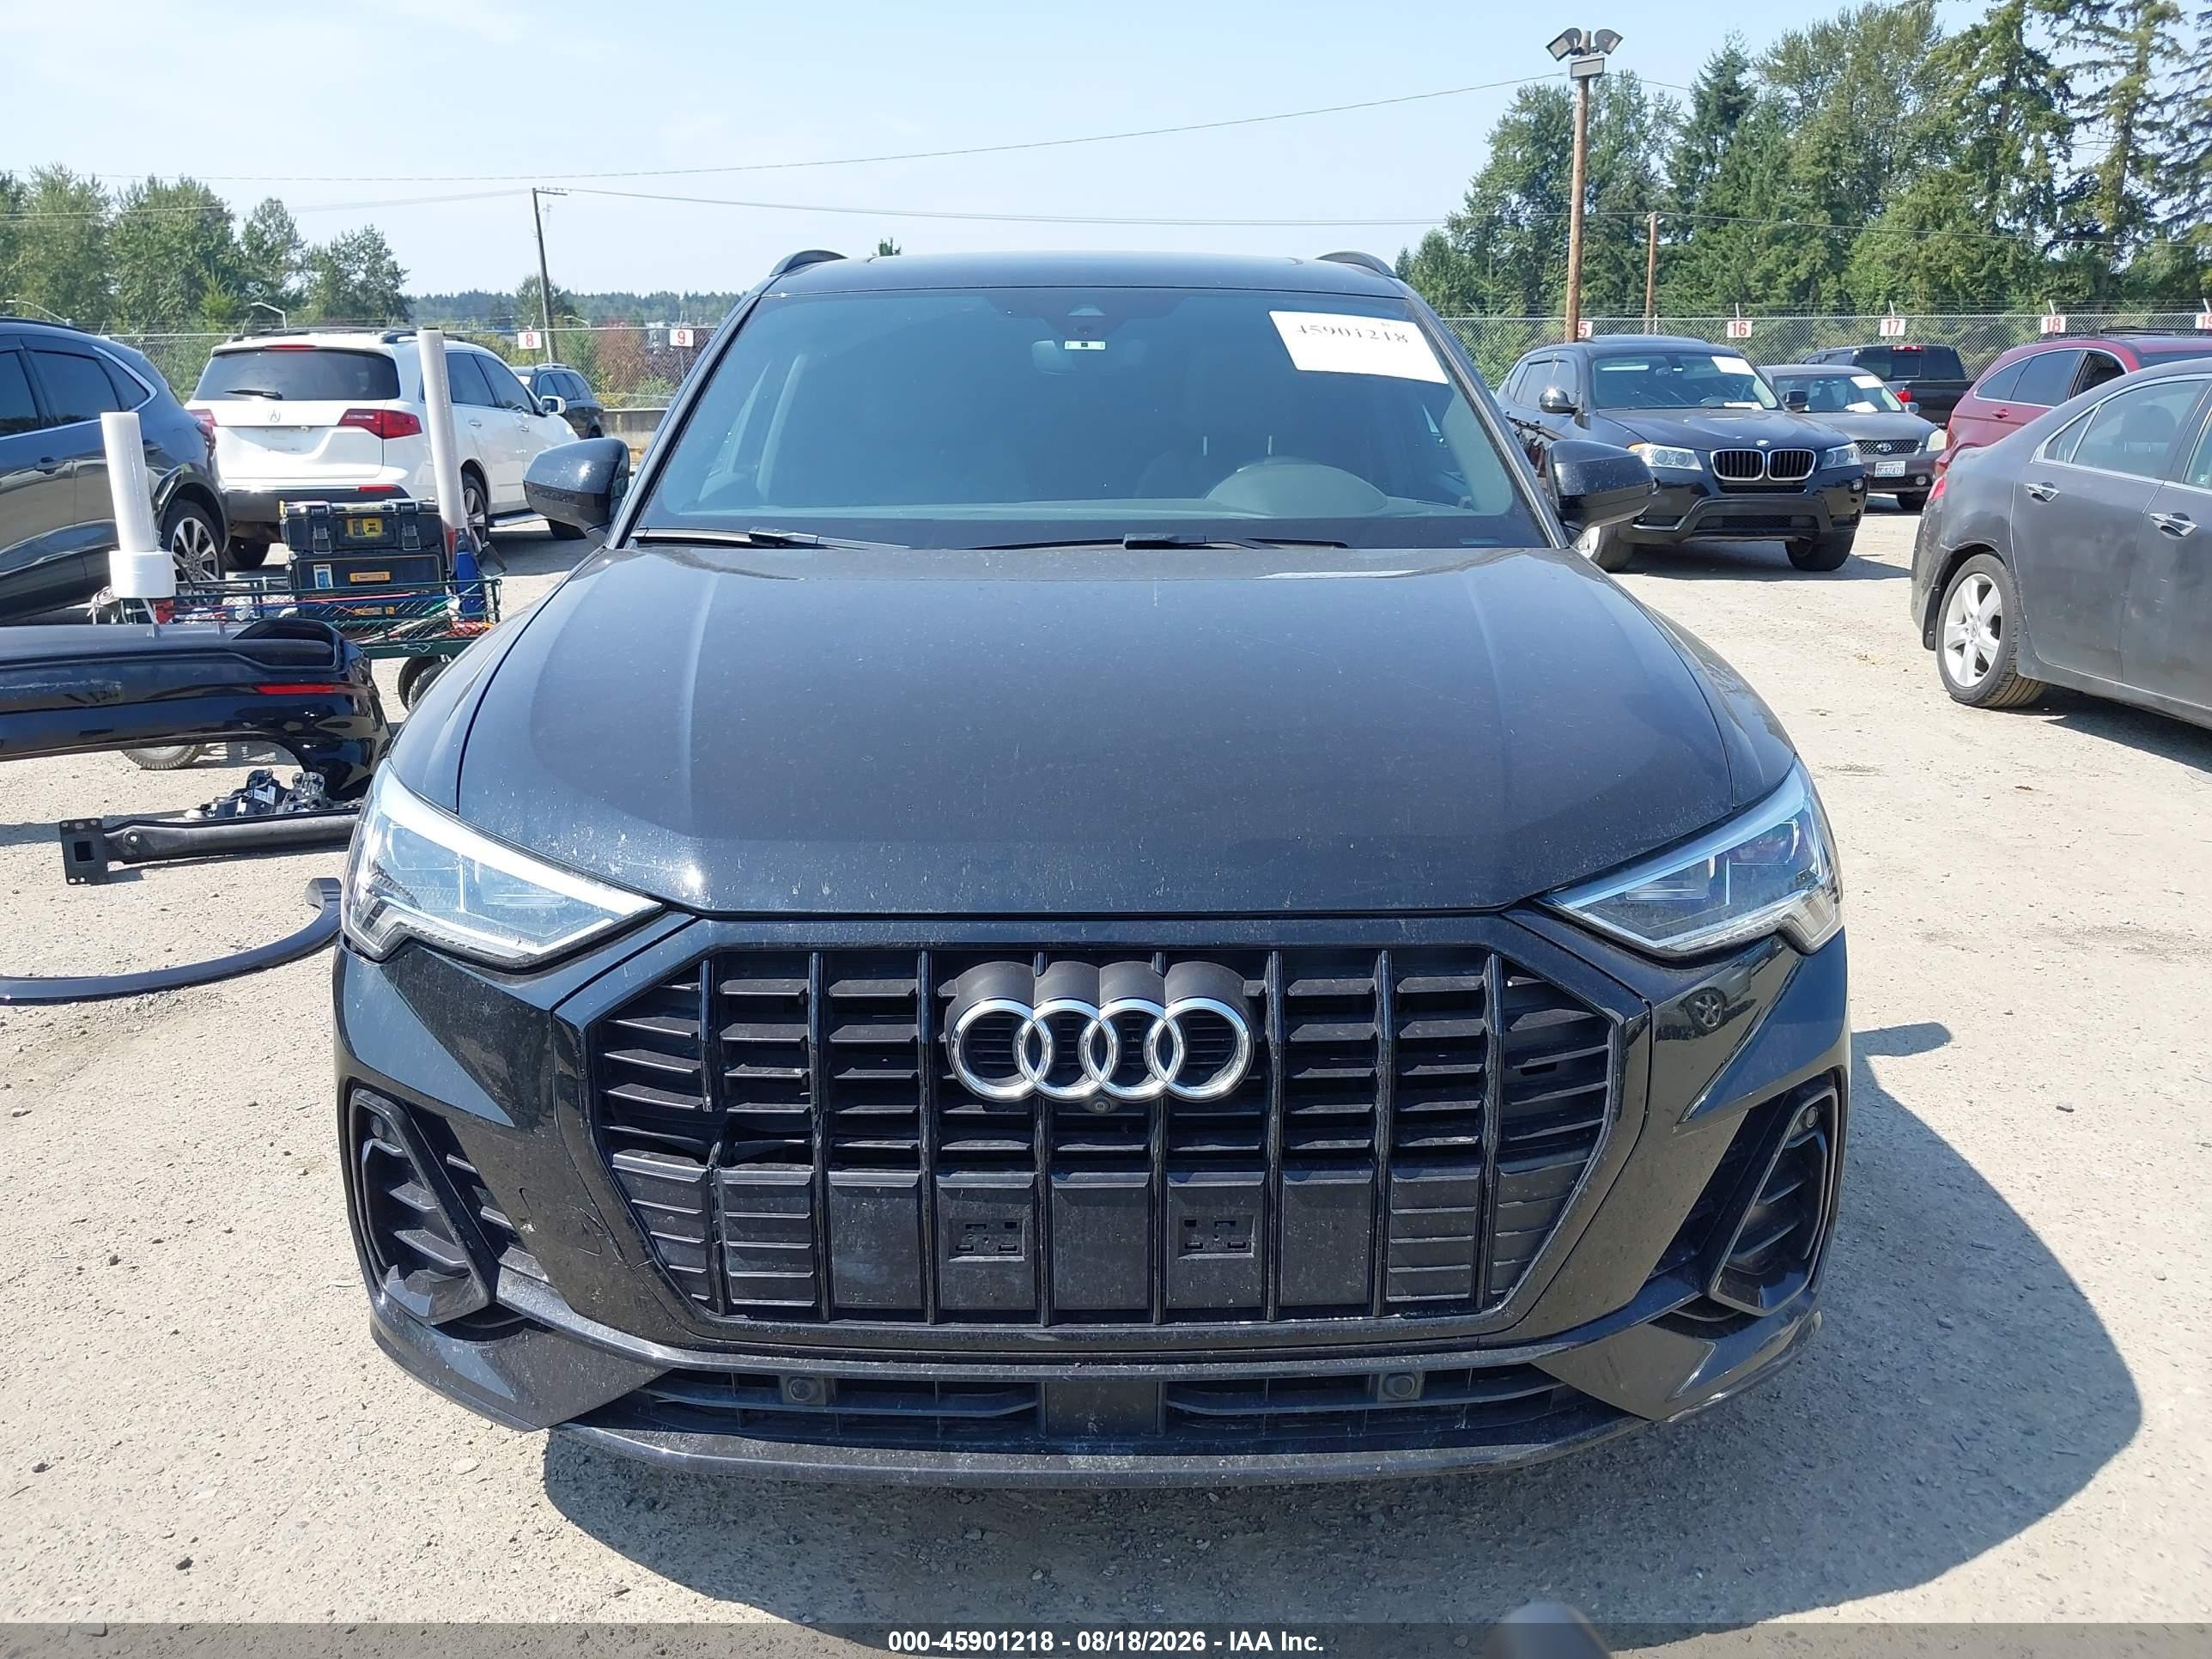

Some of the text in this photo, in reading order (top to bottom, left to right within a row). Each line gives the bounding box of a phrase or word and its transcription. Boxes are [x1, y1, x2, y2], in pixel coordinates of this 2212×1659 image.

[1731, 321, 1747, 337] 16
[1887, 319, 1900, 335] 17
[2045, 317, 2062, 332] 18
[526, 333, 534, 348] 8
[677, 330, 686, 345] 9
